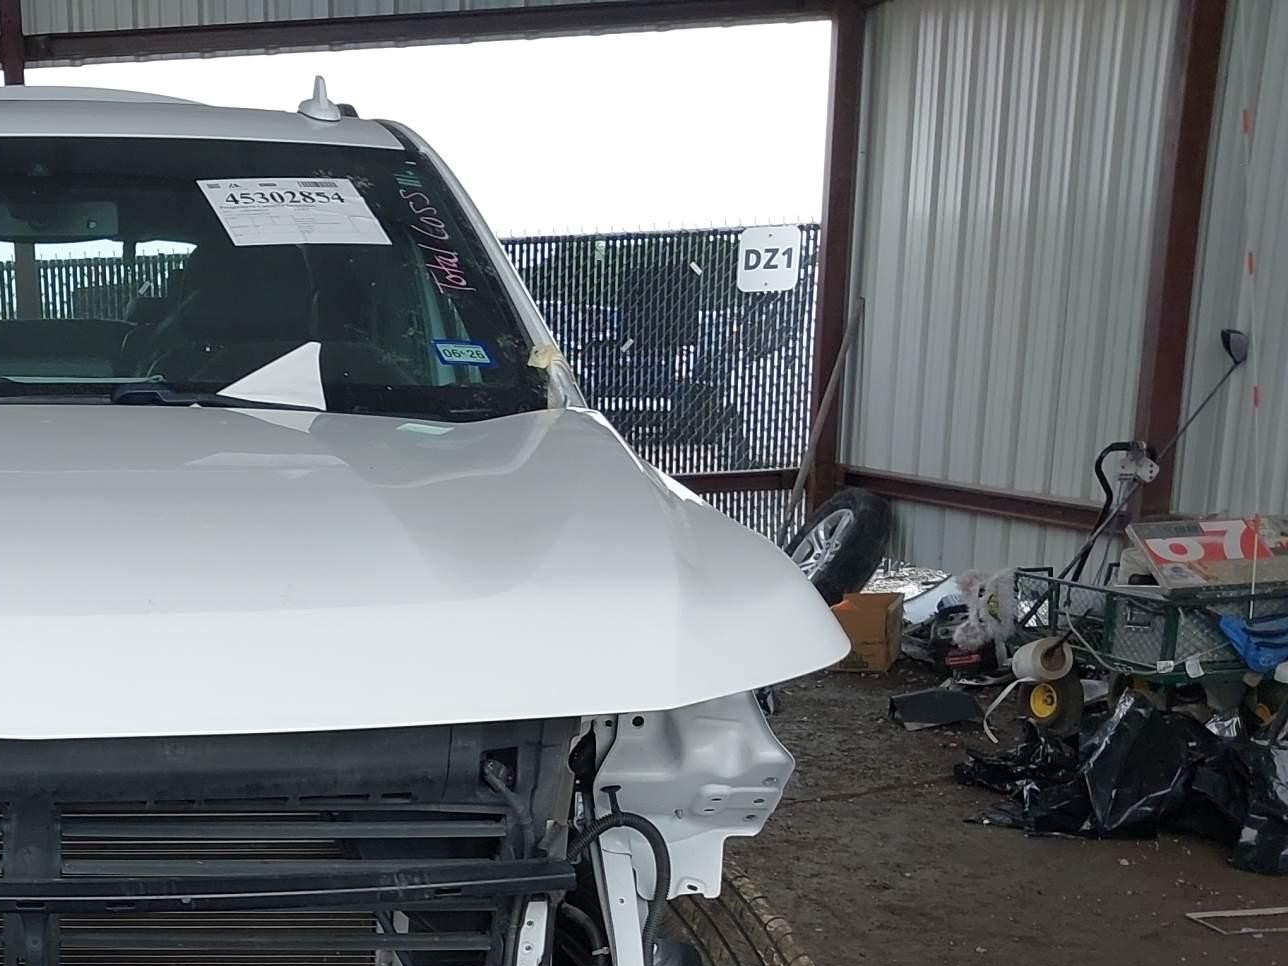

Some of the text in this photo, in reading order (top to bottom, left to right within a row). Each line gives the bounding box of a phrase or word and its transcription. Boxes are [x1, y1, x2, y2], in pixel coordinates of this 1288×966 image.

[225, 191, 345, 205] 45302854
[417, 243, 476, 293] Total
[744, 247, 793, 270] DZ1
